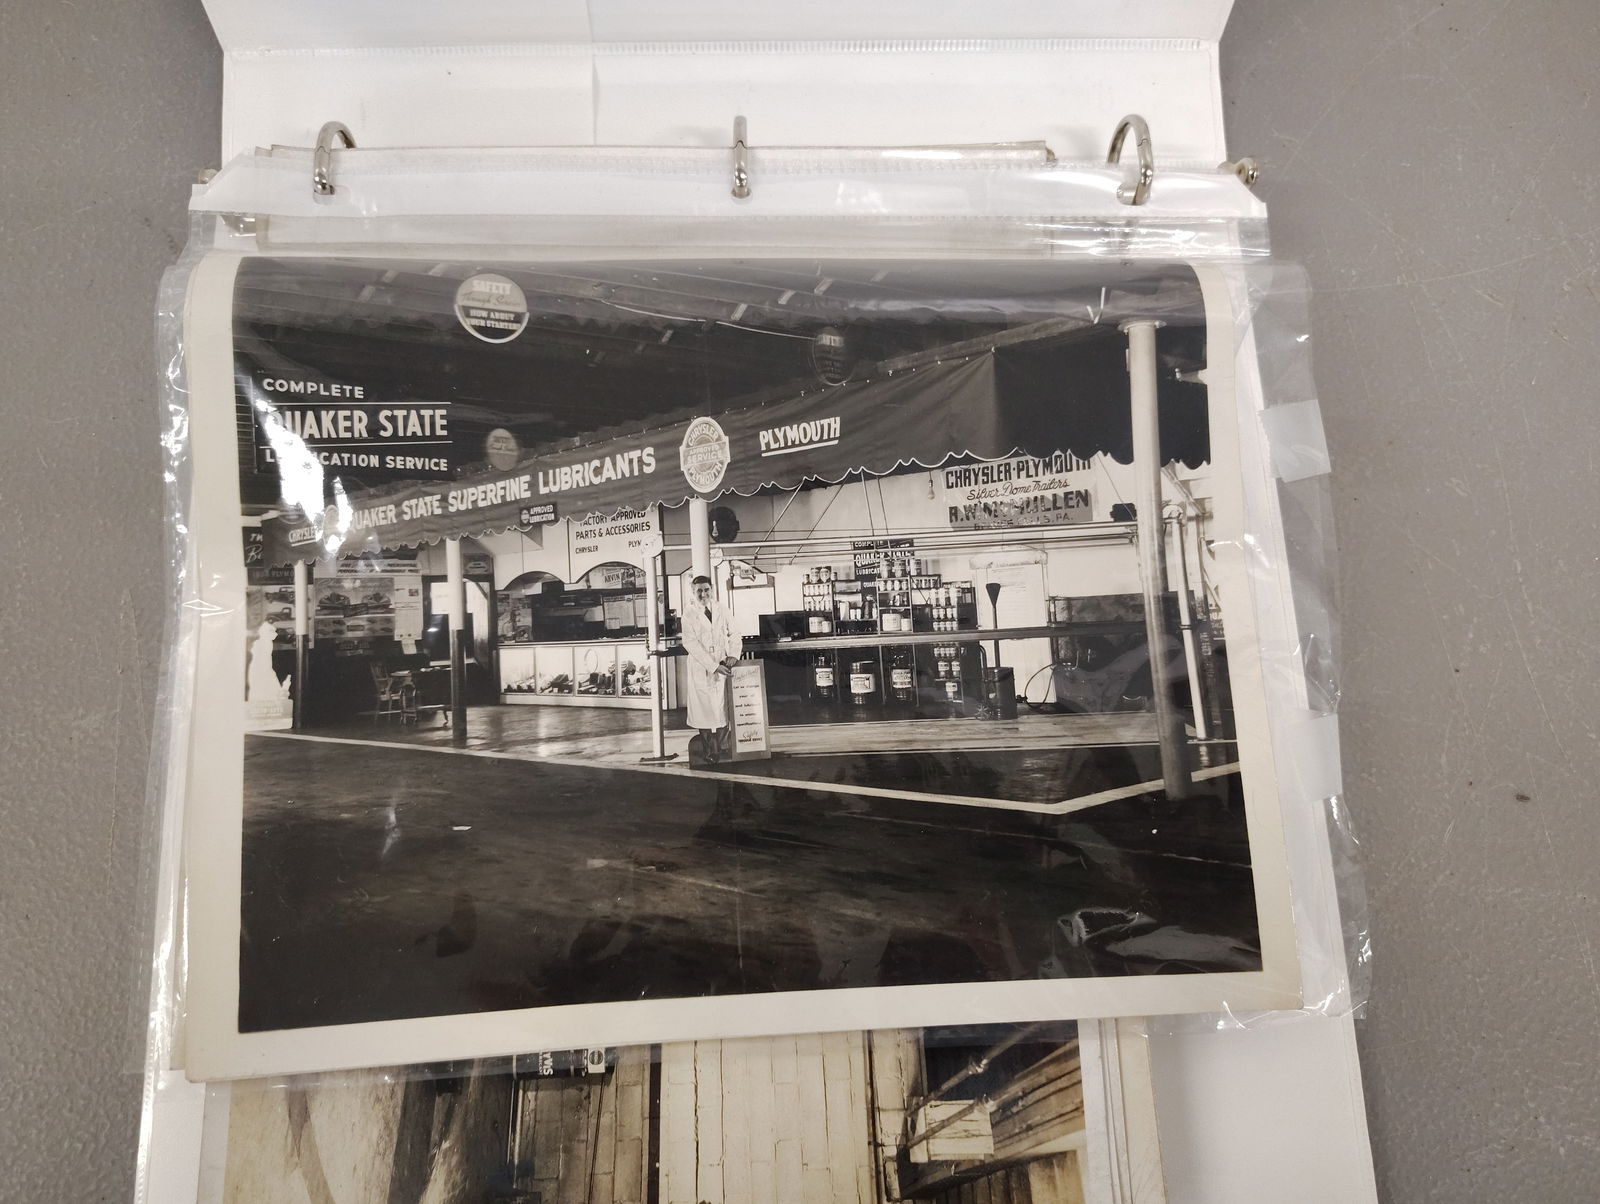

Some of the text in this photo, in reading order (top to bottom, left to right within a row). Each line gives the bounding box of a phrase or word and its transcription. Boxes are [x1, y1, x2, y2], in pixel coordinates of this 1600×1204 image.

[263, 378, 365, 399] COMPLETE
[378, 408, 449, 438] STATE
[759, 416, 841, 451] PLYMOUTH
[688, 424, 719, 447] CHRYSLER
[266, 449, 449, 471] LCATION SERVICE
[687, 450, 723, 464] SERVICE
[402, 495, 443, 521] STATE
[448, 474, 532, 513] SUPERFINE
[538, 446, 656, 495] LUBRICANTS
[689, 462, 723, 485] PLYMOUTH
[967, 478, 1070, 501] Silver Dome Trailers
[576, 521, 651, 541] PARTS & ACCESSORIES
[580, 516, 607, 528] ACTOR
[288, 526, 319, 543] CHRYSLE
[854, 539, 884, 549] COMPLTE
[575, 545, 599, 554] CHRYSLER
[604, 571, 621, 584] ARVIN
